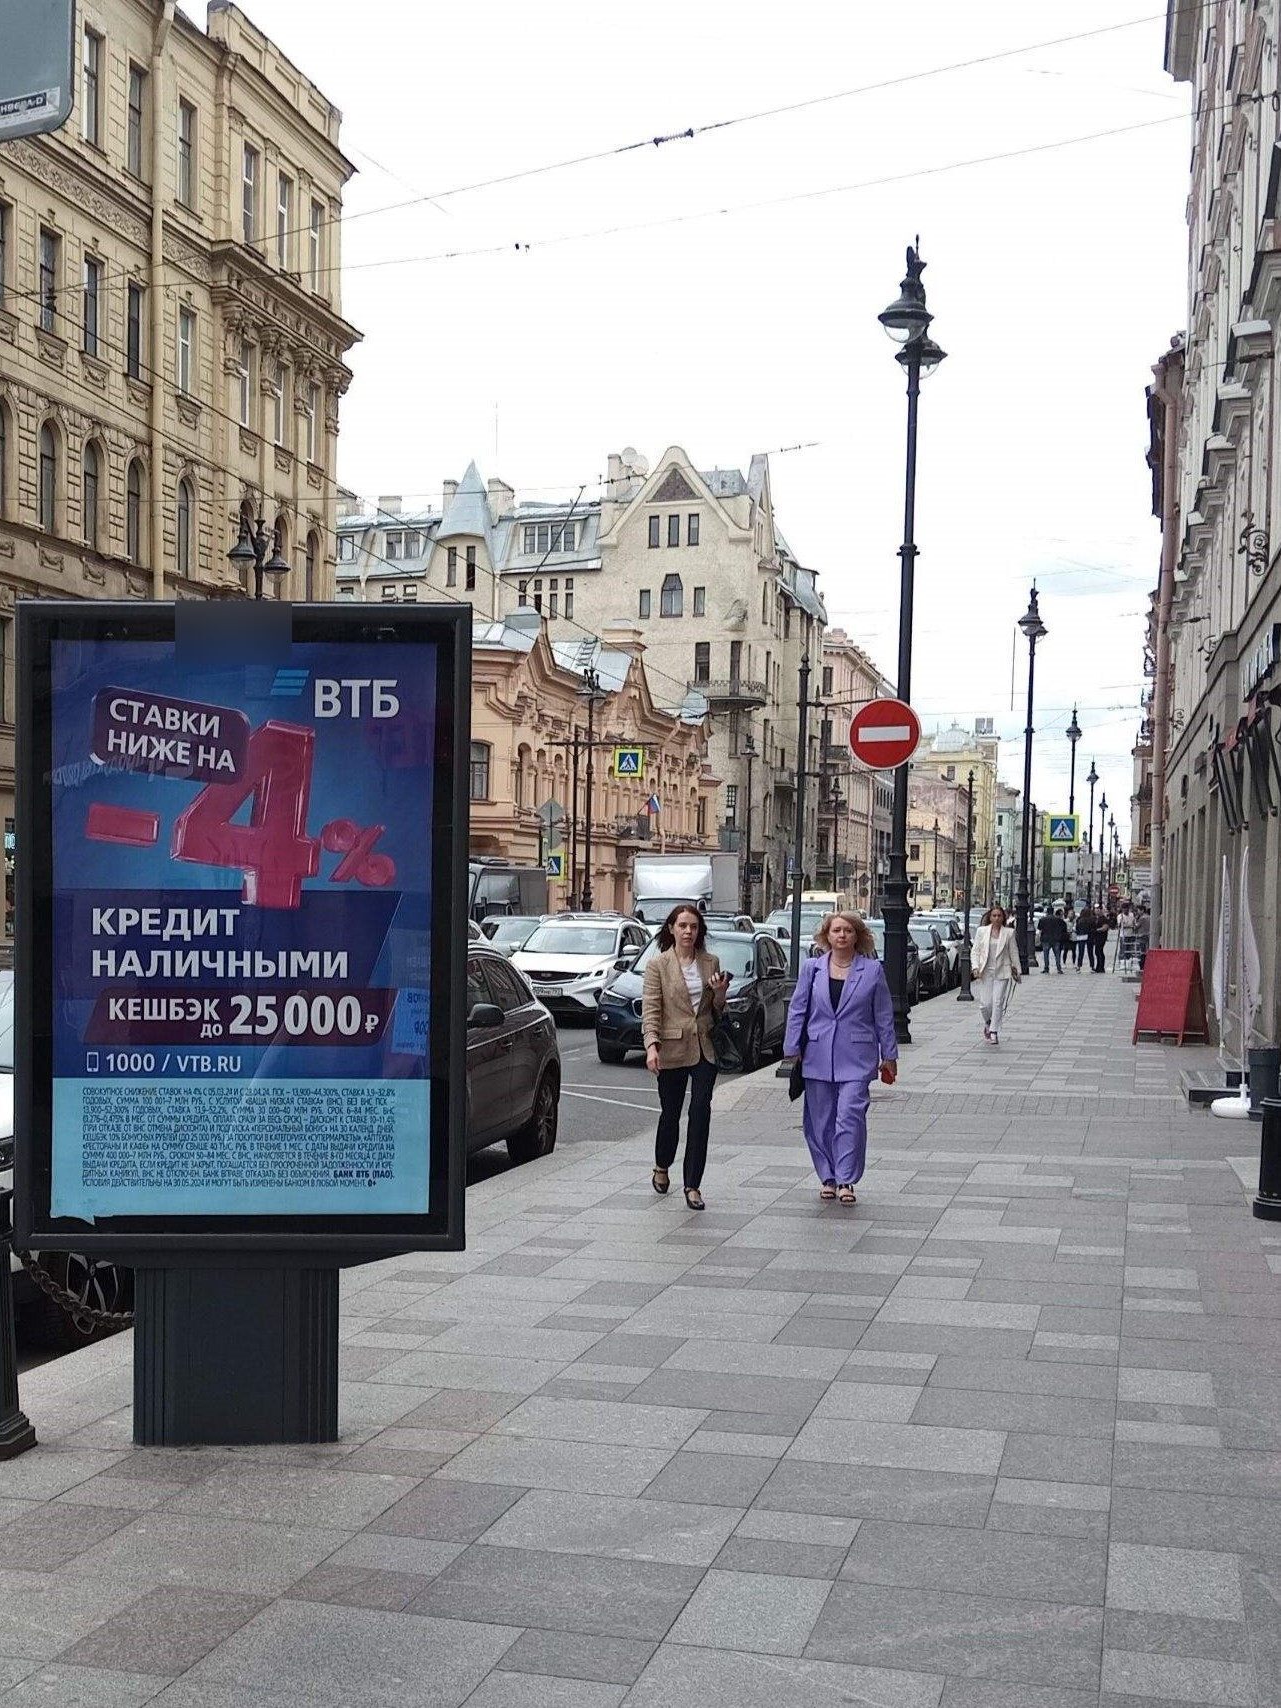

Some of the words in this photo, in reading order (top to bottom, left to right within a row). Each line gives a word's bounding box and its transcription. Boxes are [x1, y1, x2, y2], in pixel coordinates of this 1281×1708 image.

[315, 679, 400, 718] ВТБ
[109, 698, 220, 739] СТАВКИ
[107, 729, 191, 765] НИЖЕ
[198, 745, 236, 773] НА
[92, 908, 241, 941] КРЕДИТ
[92, 950, 348, 979] НАЛИЧНЫМИ
[109, 997, 221, 1021] КЕШБЭК
[106, 1053, 156, 1073] 1000
[177, 1054, 241, 1073] VTB.RU
[333, 1170, 353, 1178] БАНК
